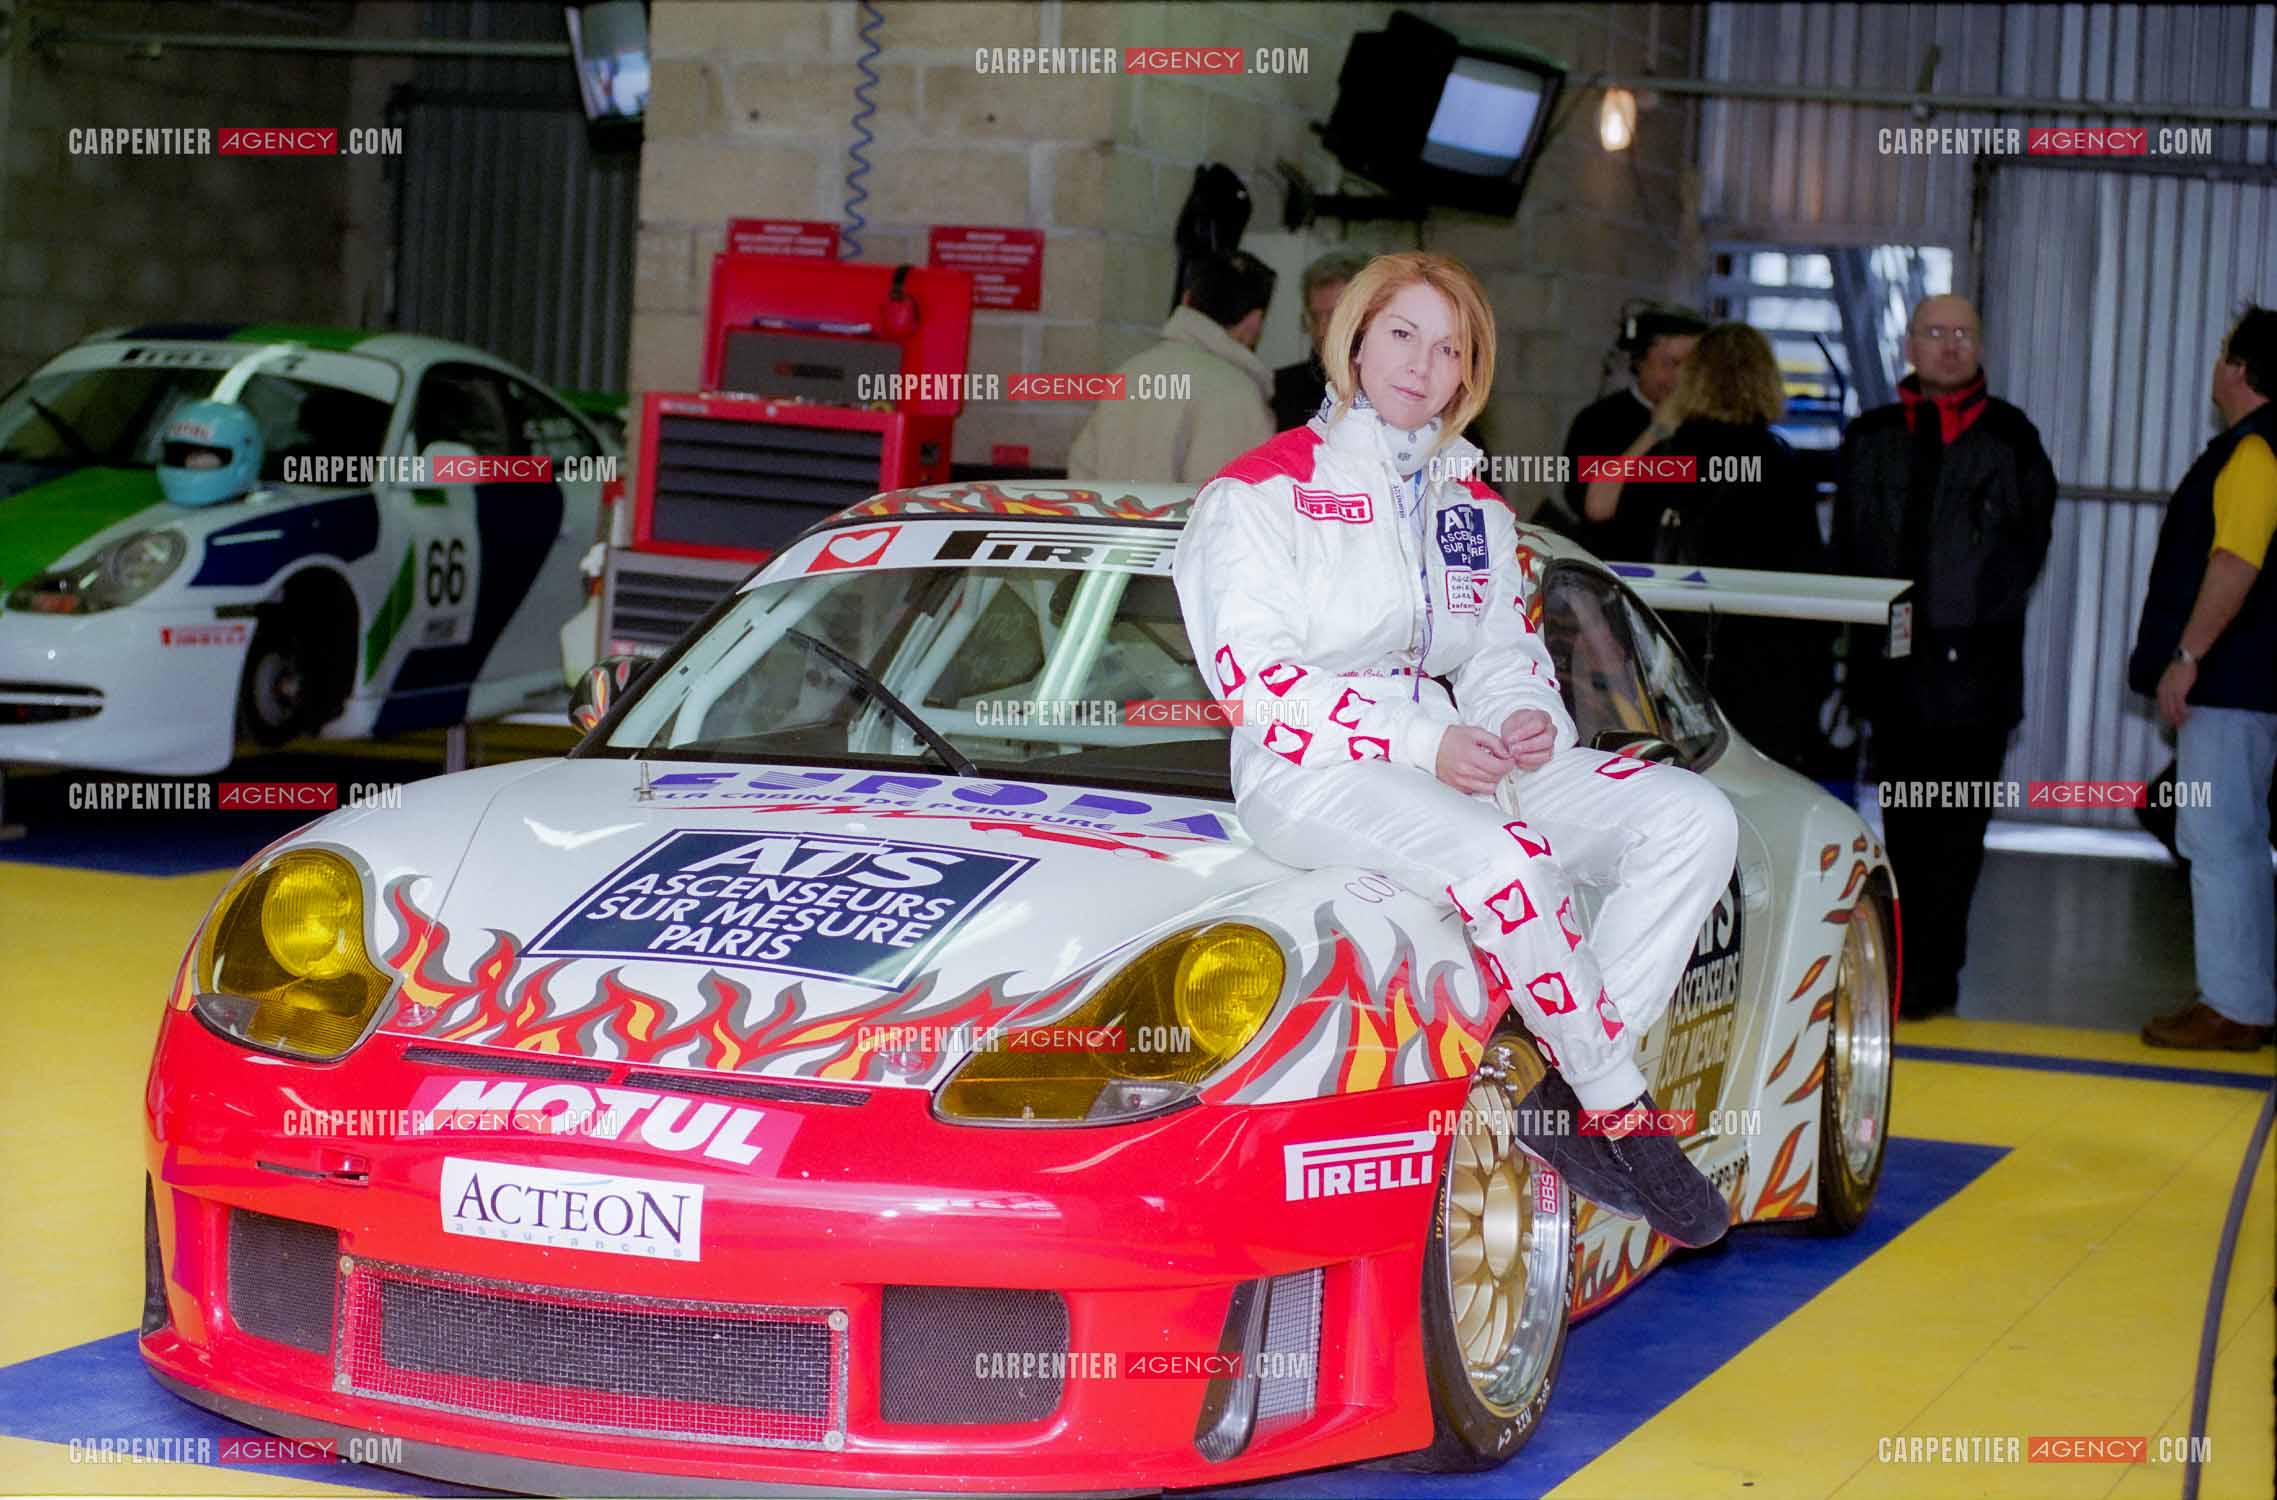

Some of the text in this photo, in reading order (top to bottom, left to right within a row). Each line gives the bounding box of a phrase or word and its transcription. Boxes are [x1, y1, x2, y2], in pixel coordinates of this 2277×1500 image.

[1298, 490, 1365, 519] PIRELLI
[1445, 506, 1474, 532] AT
[934, 530, 1176, 568] PIRE
[427, 539, 466, 607] 66
[720, 792, 855, 803] CABINE
[864, 798, 920, 807] DE
[927, 802, 1116, 831] PEINTURE
[678, 838, 966, 888] ATS
[614, 873, 956, 921] ASCENSEURS
[583, 896, 932, 949] SUR MESURE
[647, 924, 802, 960] PARIS
[420, 1079, 765, 1166] MOTUL
[1283, 1130, 1437, 1201] PIRELLI
[454, 1172, 691, 1243] ACTEON
[1541, 1172, 1556, 1214] BBS
[455, 1224, 682, 1258] assurances
